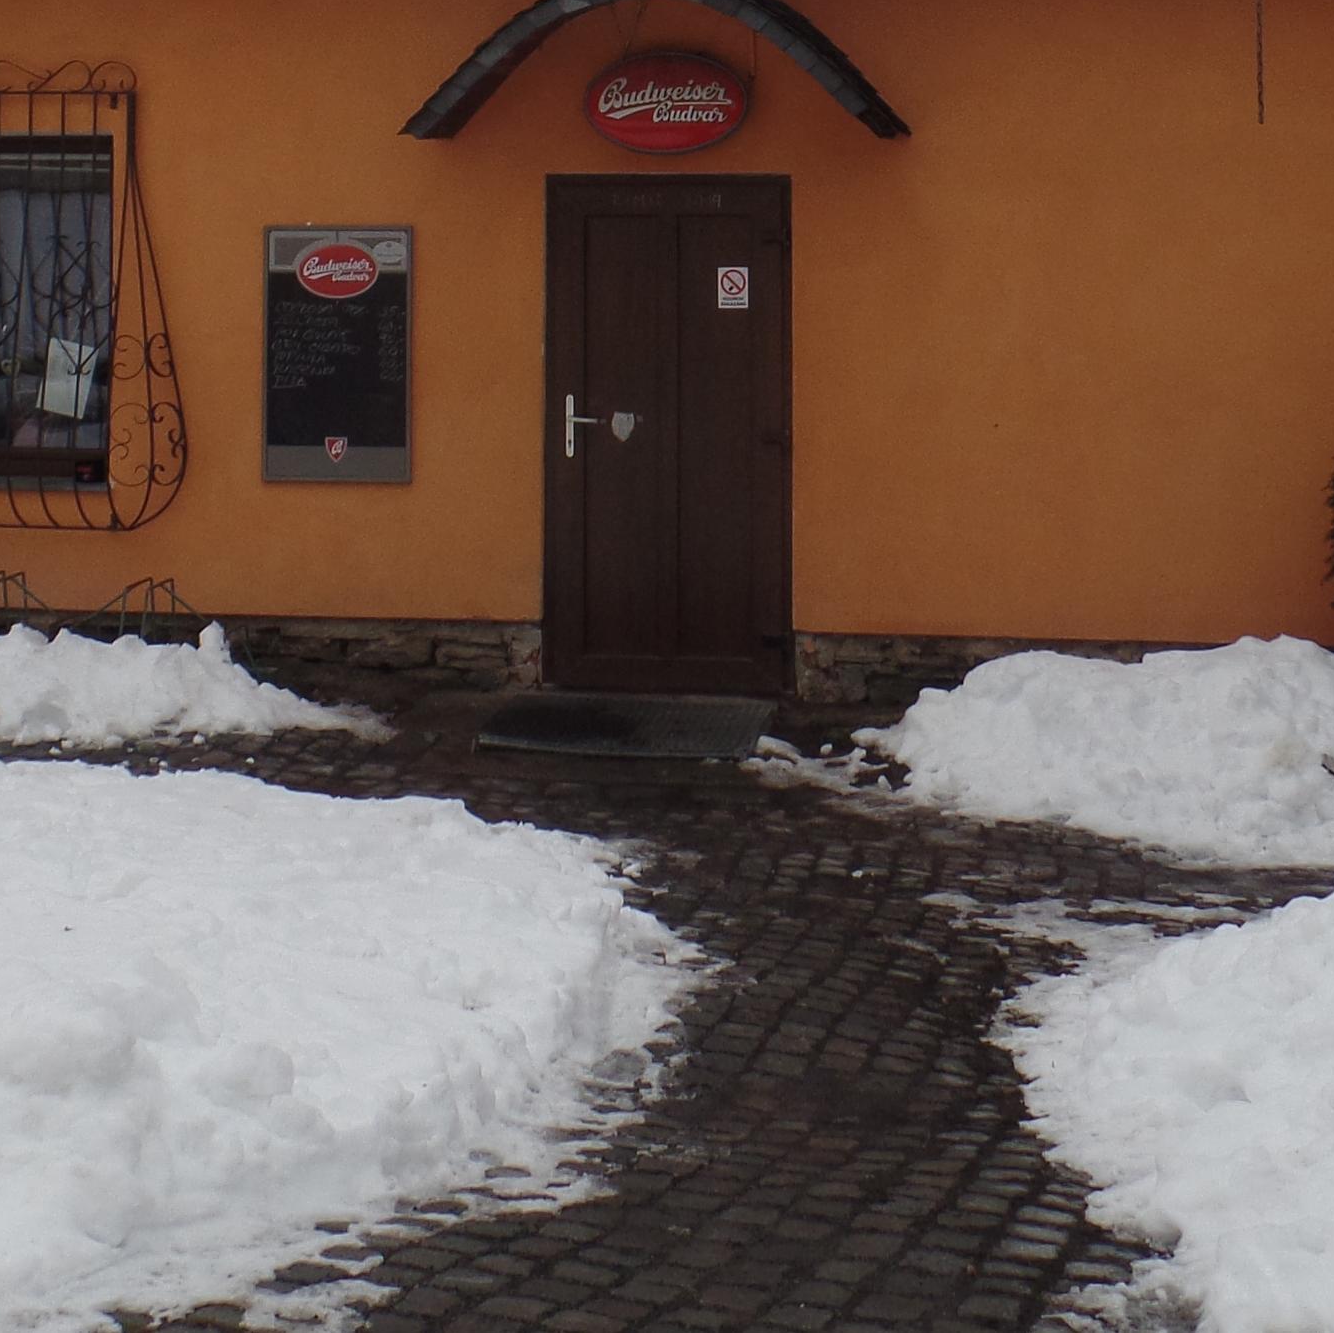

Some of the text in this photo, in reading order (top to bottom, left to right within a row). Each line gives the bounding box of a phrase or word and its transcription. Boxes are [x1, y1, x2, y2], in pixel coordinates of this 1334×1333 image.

[598, 77, 729, 113] Budweiser
[652, 101, 727, 123] Budvar
[303, 257, 371, 276] Budweiser
